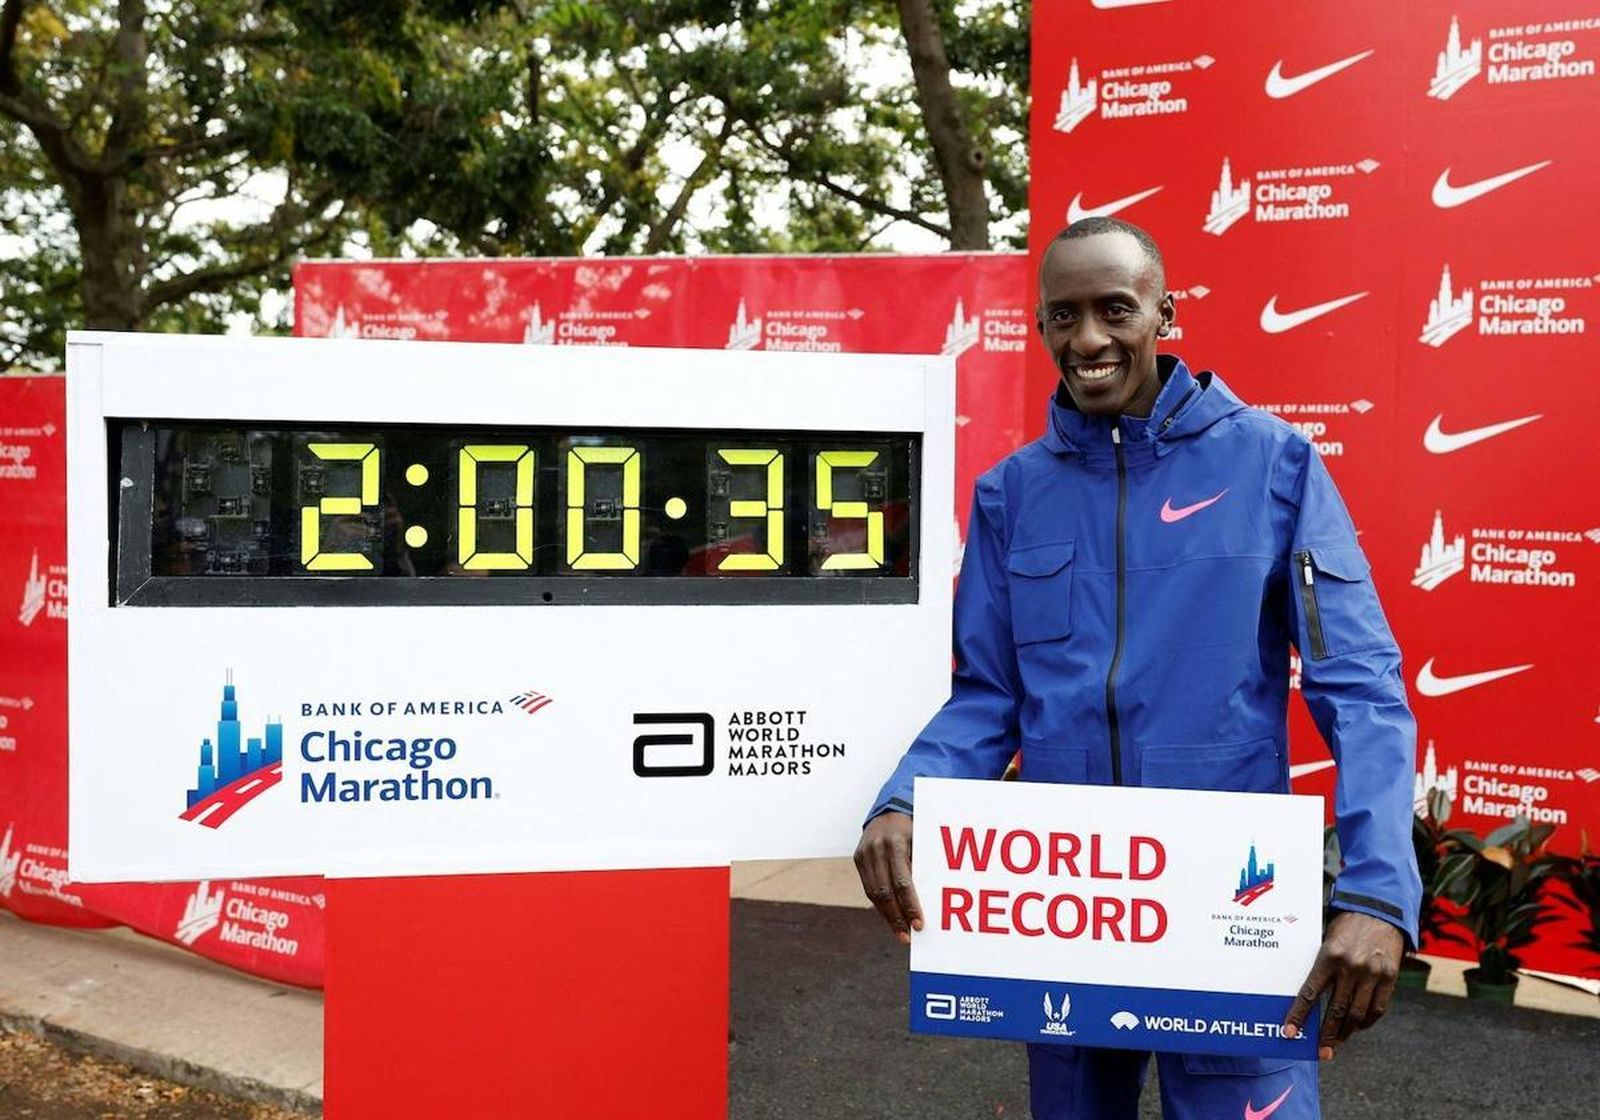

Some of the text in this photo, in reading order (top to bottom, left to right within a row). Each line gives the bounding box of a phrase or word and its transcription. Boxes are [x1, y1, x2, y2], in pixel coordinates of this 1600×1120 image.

[1489, 18, 1600, 38] BANK OF AMERICA
[1488, 40, 1575, 62] Chicago
[1102, 61, 1192, 78] BANK OF AMERICA
[1488, 60, 1595, 83] Marathon
[1102, 80, 1171, 99] Chicago
[1102, 98, 1187, 118] Marathon
[1256, 165, 1355, 180] BANK OF AMERICA
[1256, 182, 1332, 203] Chicago
[1256, 202, 1349, 222] Marathon
[1481, 277, 1592, 290] BANK OF AMERICA
[1480, 294, 1565, 317] Chicago
[558, 322, 616, 340] Chicago
[766, 321, 827, 340] Chicago
[1479, 315, 1584, 335] Marathon
[1472, 528, 1583, 542] BANK OF AMERICA
[1471, 543, 1556, 568] Chicago
[1471, 564, 1575, 587] Marathon
[301, 701, 504, 716] BANK OF AMERICA
[729, 711, 807, 725] ABBOTT
[728, 728, 799, 742] WORLD
[301, 731, 457, 769] Chicago
[729, 744, 845, 759] MARATHON
[729, 761, 811, 776] MAJORS
[1464, 760, 1574, 780] BANK OF AMERICA
[301, 770, 493, 803] Marathon
[1464, 775, 1548, 803] Chicago
[1463, 795, 1567, 824] Marathon
[940, 826, 1167, 881] WORLD
[226, 898, 289, 932] Chicago
[941, 887, 1168, 944] RECORD
[220, 921, 298, 957] Marathon
[1230, 925, 1274, 939] Chicago
[1224, 937, 1279, 949] Marathon
[1144, 1016, 1207, 1033] WORLD
